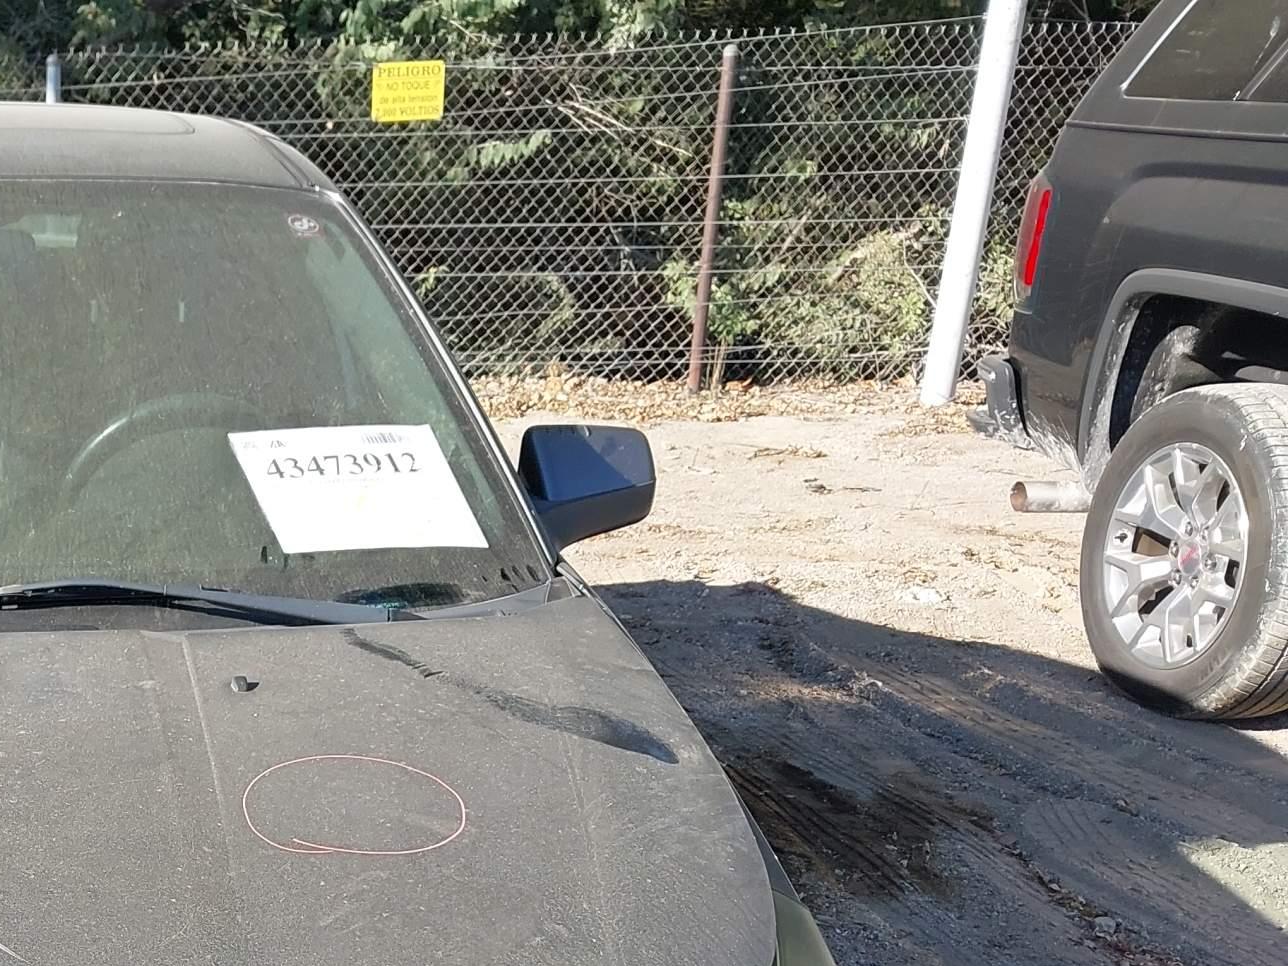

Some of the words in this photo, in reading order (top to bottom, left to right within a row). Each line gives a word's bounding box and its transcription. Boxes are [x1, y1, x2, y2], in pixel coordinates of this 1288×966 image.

[378, 65, 440, 77] PELIGRO
[386, 81, 399, 91] NO
[402, 80, 430, 90] TOQUE
[266, 452, 421, 478] 43473912
